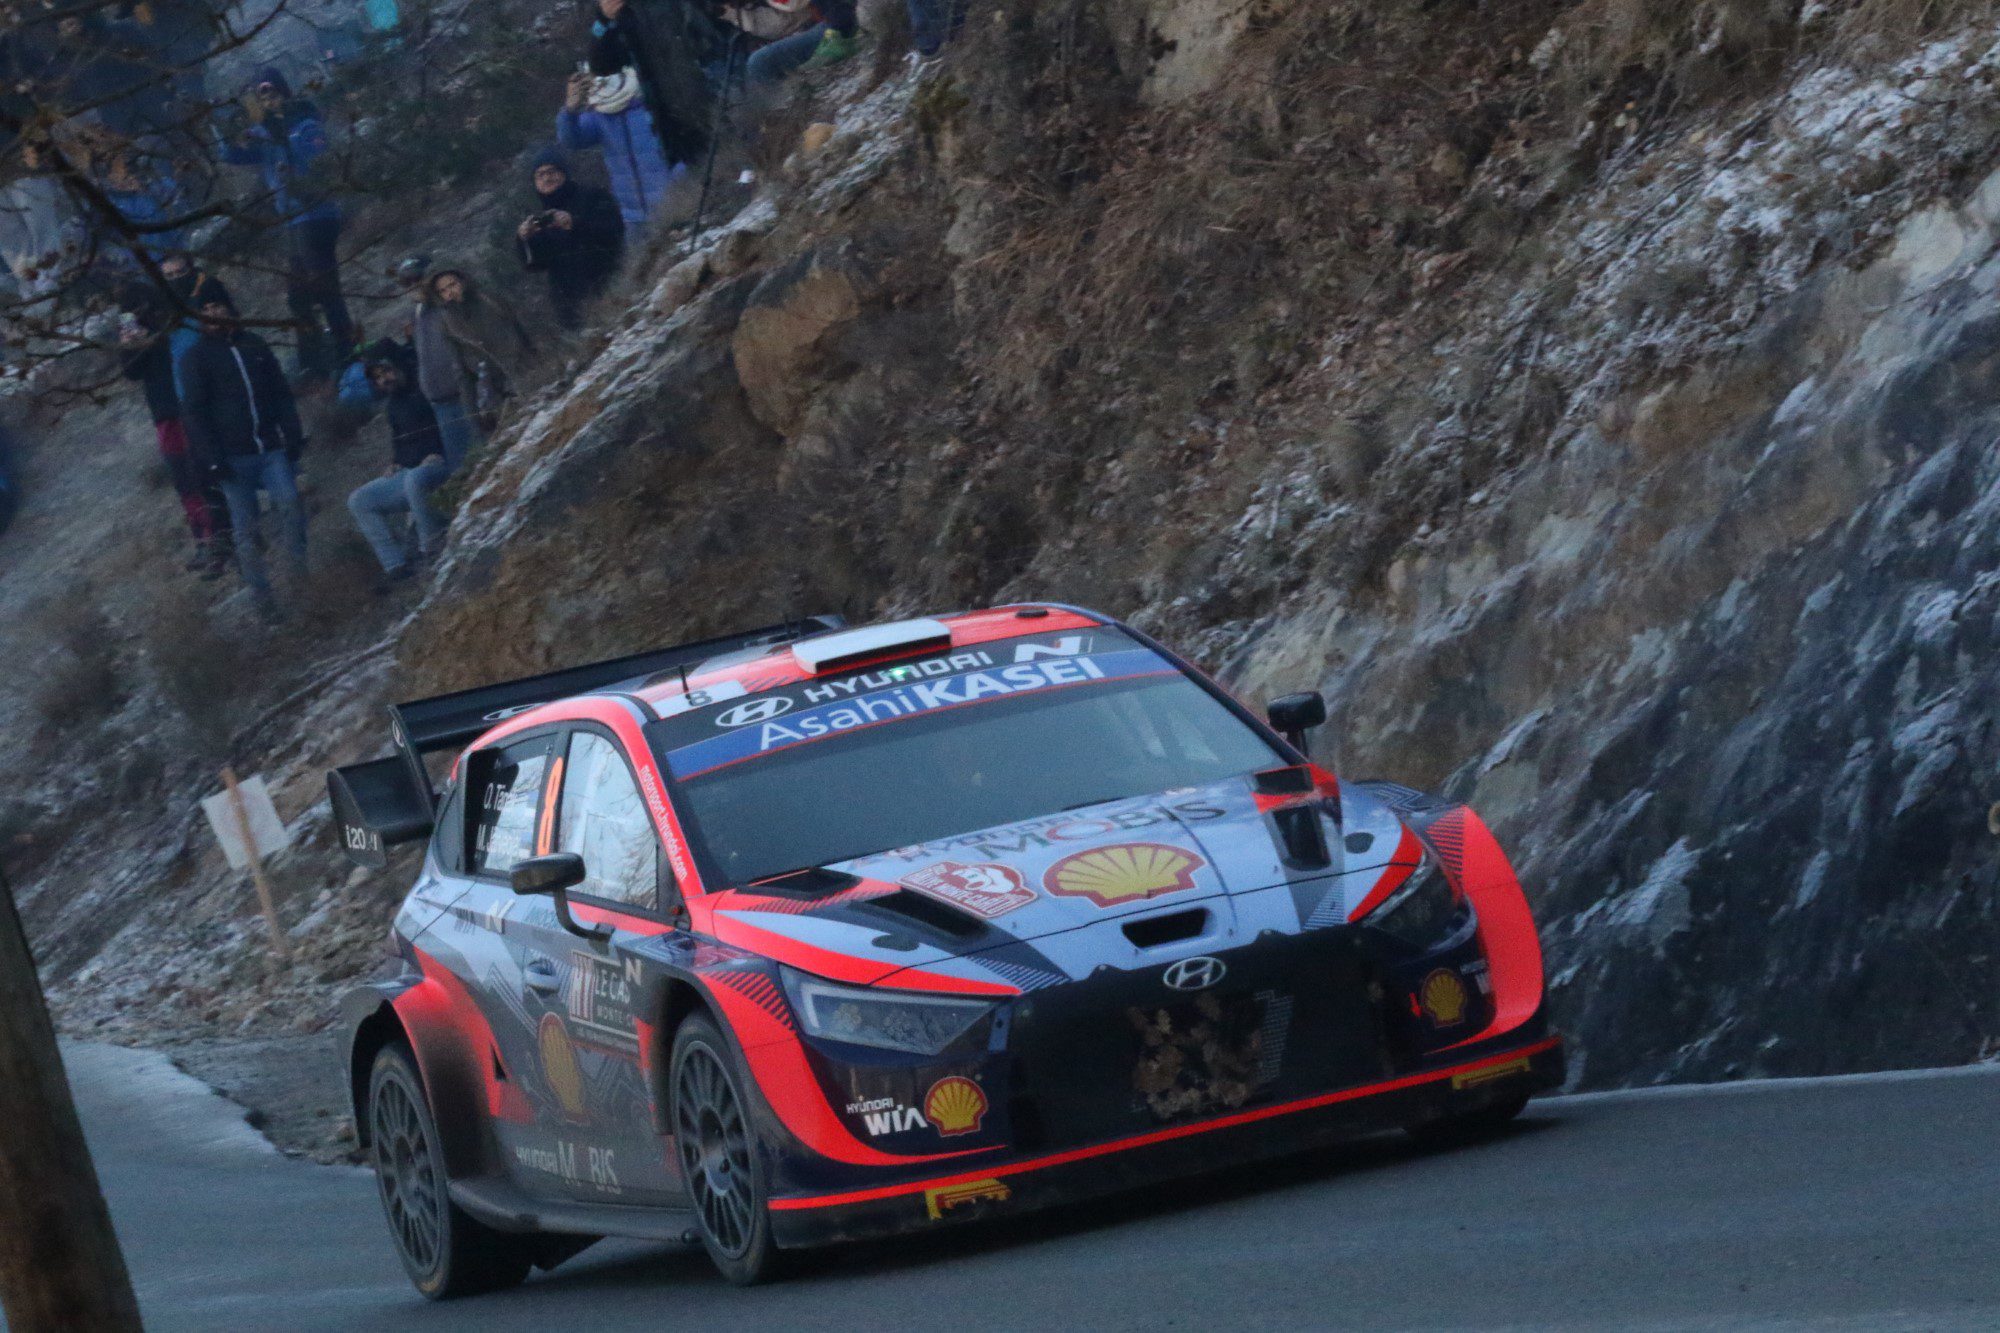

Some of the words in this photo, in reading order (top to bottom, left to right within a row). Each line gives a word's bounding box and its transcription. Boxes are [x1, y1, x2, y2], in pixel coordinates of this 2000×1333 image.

[803, 651, 993, 703] HYUNDAI
[974, 800, 1227, 860] MOBIS
[846, 1097, 894, 1114] HYUNDAI
